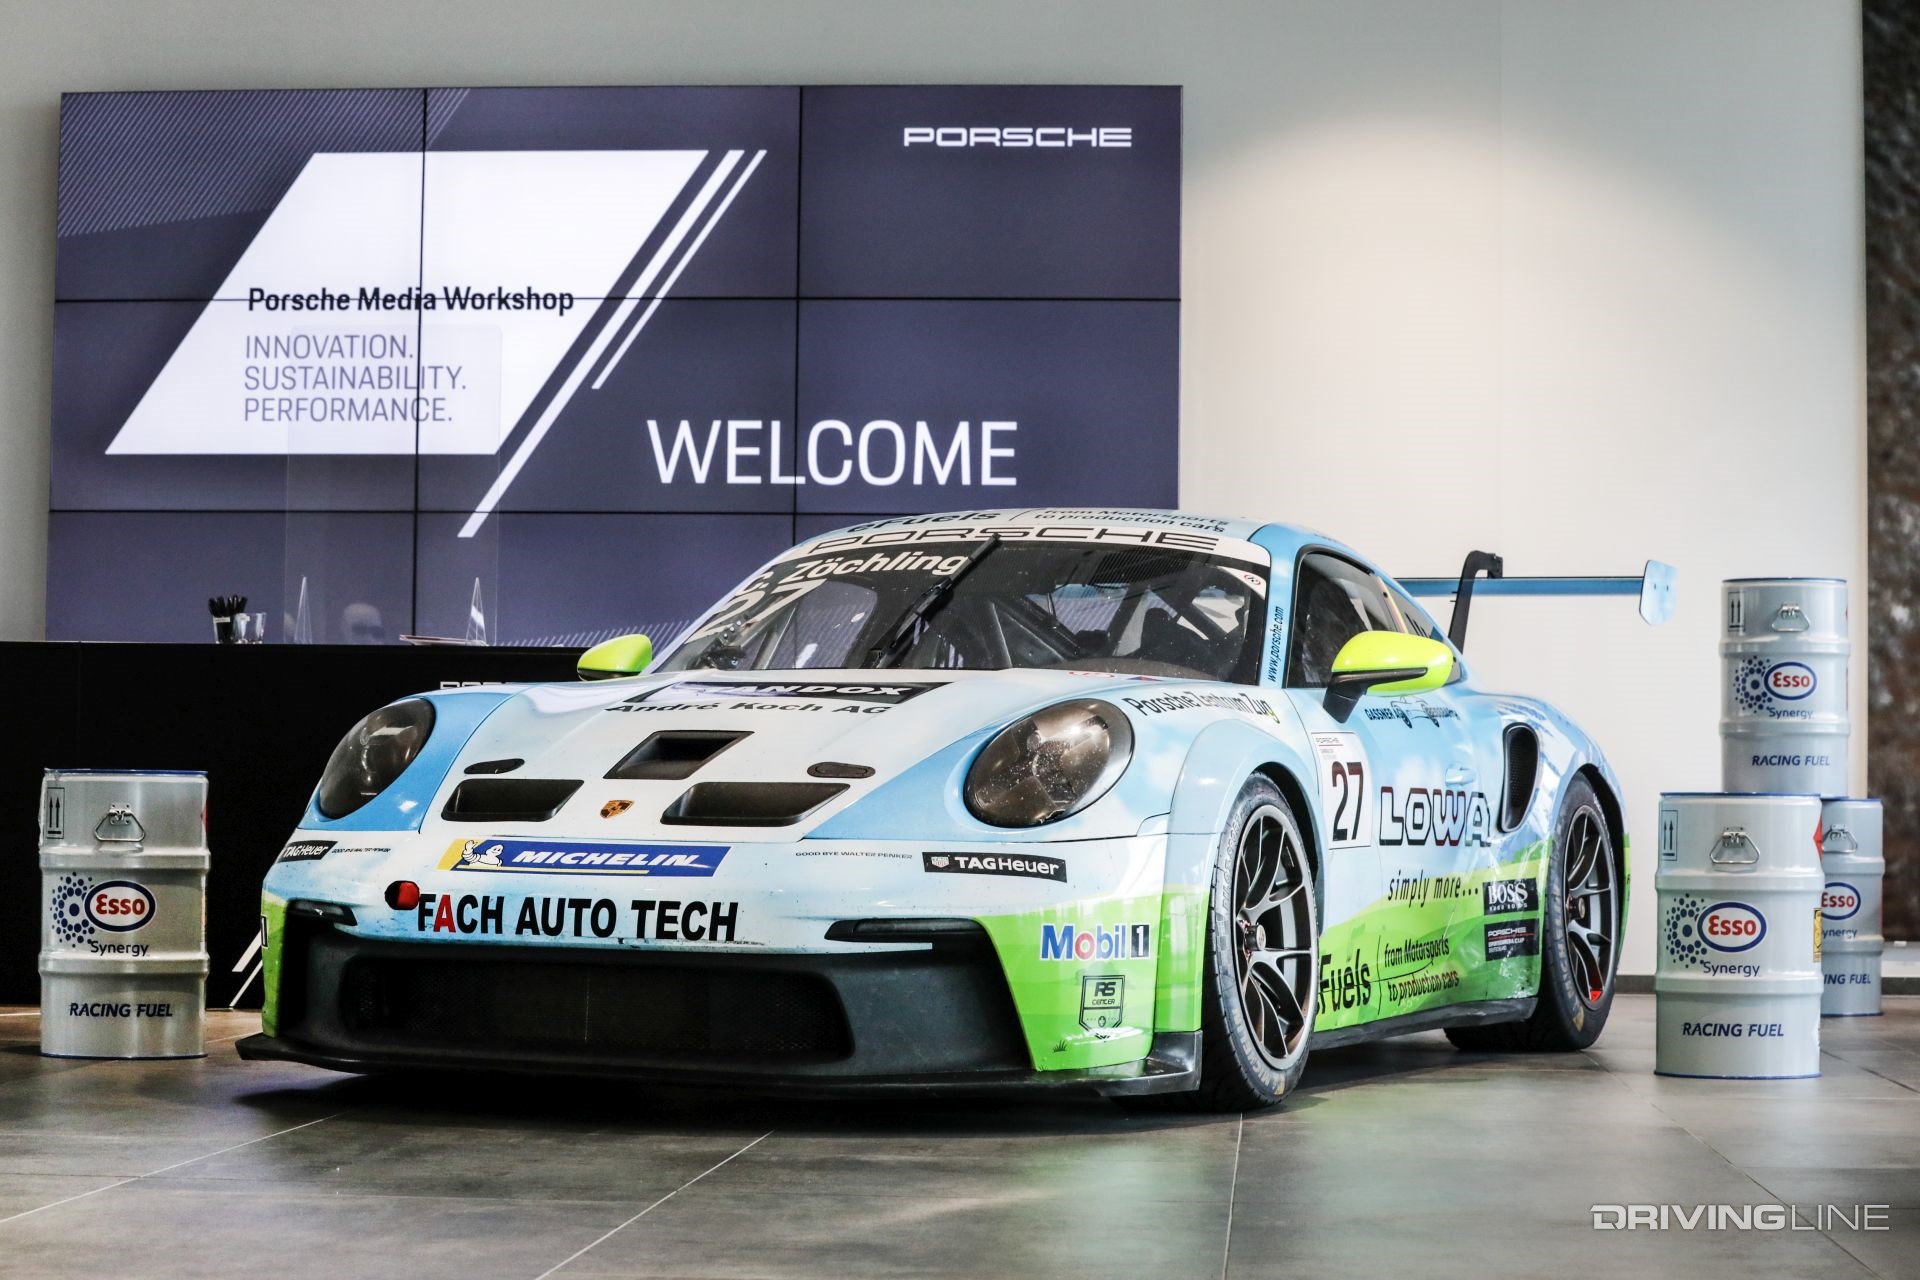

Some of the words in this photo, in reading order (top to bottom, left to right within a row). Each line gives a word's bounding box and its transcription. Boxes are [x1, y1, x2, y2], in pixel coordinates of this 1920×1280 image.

[904, 128, 1132, 147] PORSCHE
[248, 287, 350, 311] Porsche
[357, 287, 437, 311] Media
[443, 286, 574, 316] Workshop
[245, 334, 414, 360] INNOVATION.
[244, 365, 467, 390] SUSTAINABILITY.
[244, 397, 453, 422] PERFORMANCE.
[647, 419, 1017, 486] WELCOME
[848, 512, 1001, 533] eFuels
[1058, 514, 1179, 527] production
[1182, 521, 1225, 533] cars
[1098, 510, 1230, 526] Motorsports
[808, 526, 1219, 553] PORSCHE
[779, 551, 970, 584] Zöchling
[1268, 606, 1284, 683] www.porsche.com
[1773, 671, 1810, 688] Esso
[605, 701, 718, 713] André
[728, 702, 824, 713] Koch
[831, 705, 893, 714] AG
[1121, 692, 1196, 717] Porsche
[1769, 707, 1813, 719] Synergy
[1751, 755, 1801, 766] RACING
[1804, 755, 1830, 766] FUEL
[1331, 760, 1365, 843] 27
[1379, 786, 1491, 847] LOWA
[512, 850, 709, 868] MICHELIN
[1388, 869, 1430, 908] simply
[1488, 882, 1528, 905] BOSS
[95, 894, 146, 915] Esso
[417, 893, 505, 935] FACH
[515, 896, 617, 939] AUTO
[630, 899, 738, 942] TECH
[1708, 915, 1757, 936] Esso
[1041, 924, 1126, 960] Mobil
[1823, 928, 1857, 939] ynergy
[90, 940, 149, 956] Synergy
[1384, 943, 1403, 967] from
[1404, 936, 1450, 963] Motorsports
[1703, 961, 1760, 977] Synergy
[1850, 973, 1871, 985] FUEL
[1316, 949, 1371, 1014] Fuels
[1388, 980, 1398, 1002] to
[1399, 970, 1442, 1006] production
[1443, 970, 1460, 990] cars
[69, 1002, 131, 1017] RACING
[136, 1003, 173, 1017] FUEL
[1682, 1022, 1743, 1037] RACING
[1748, 1023, 1785, 1037] FUEL
